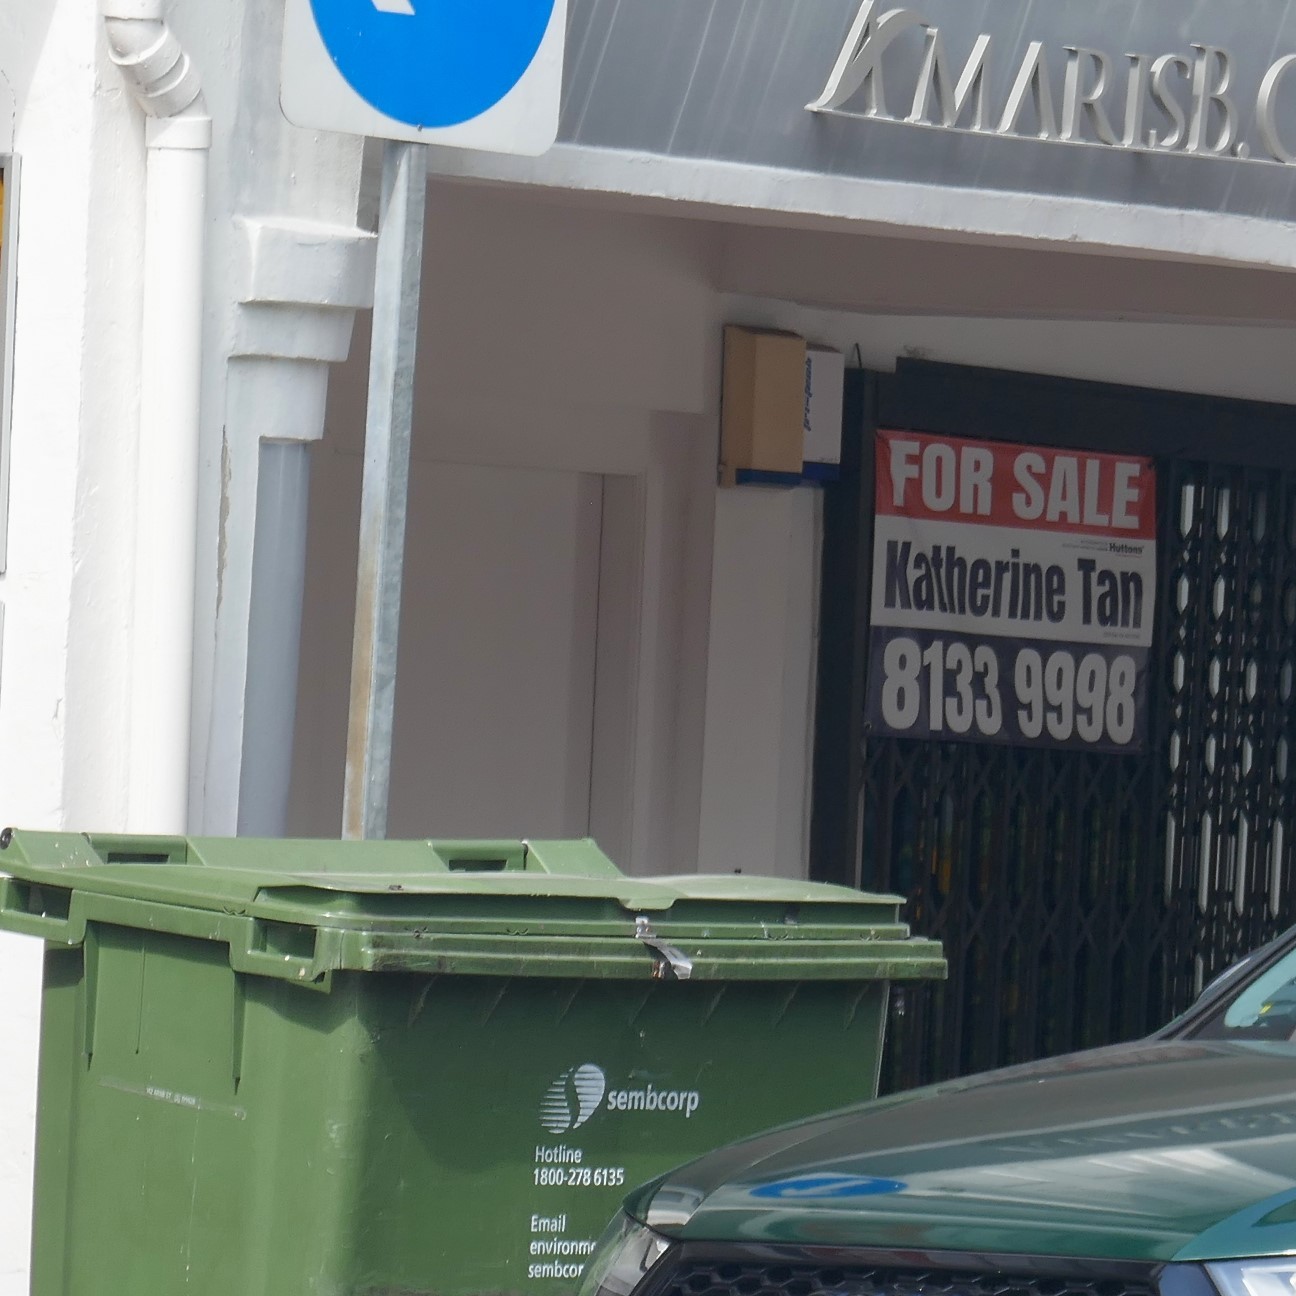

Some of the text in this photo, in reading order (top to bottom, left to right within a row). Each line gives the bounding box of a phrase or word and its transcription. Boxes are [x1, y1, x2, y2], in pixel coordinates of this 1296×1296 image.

[889, 440, 1141, 529] FOR SALE
[1109, 543, 1143, 555] Huttons
[884, 540, 1142, 628] Katherine Tan
[882, 637, 1137, 745] 8133 9998
[607, 1084, 699, 1118] sembcorp
[534, 1145, 583, 1164] Hotline
[533, 1167, 625, 1186] 1800-278 6135
[530, 1214, 566, 1233] Email
